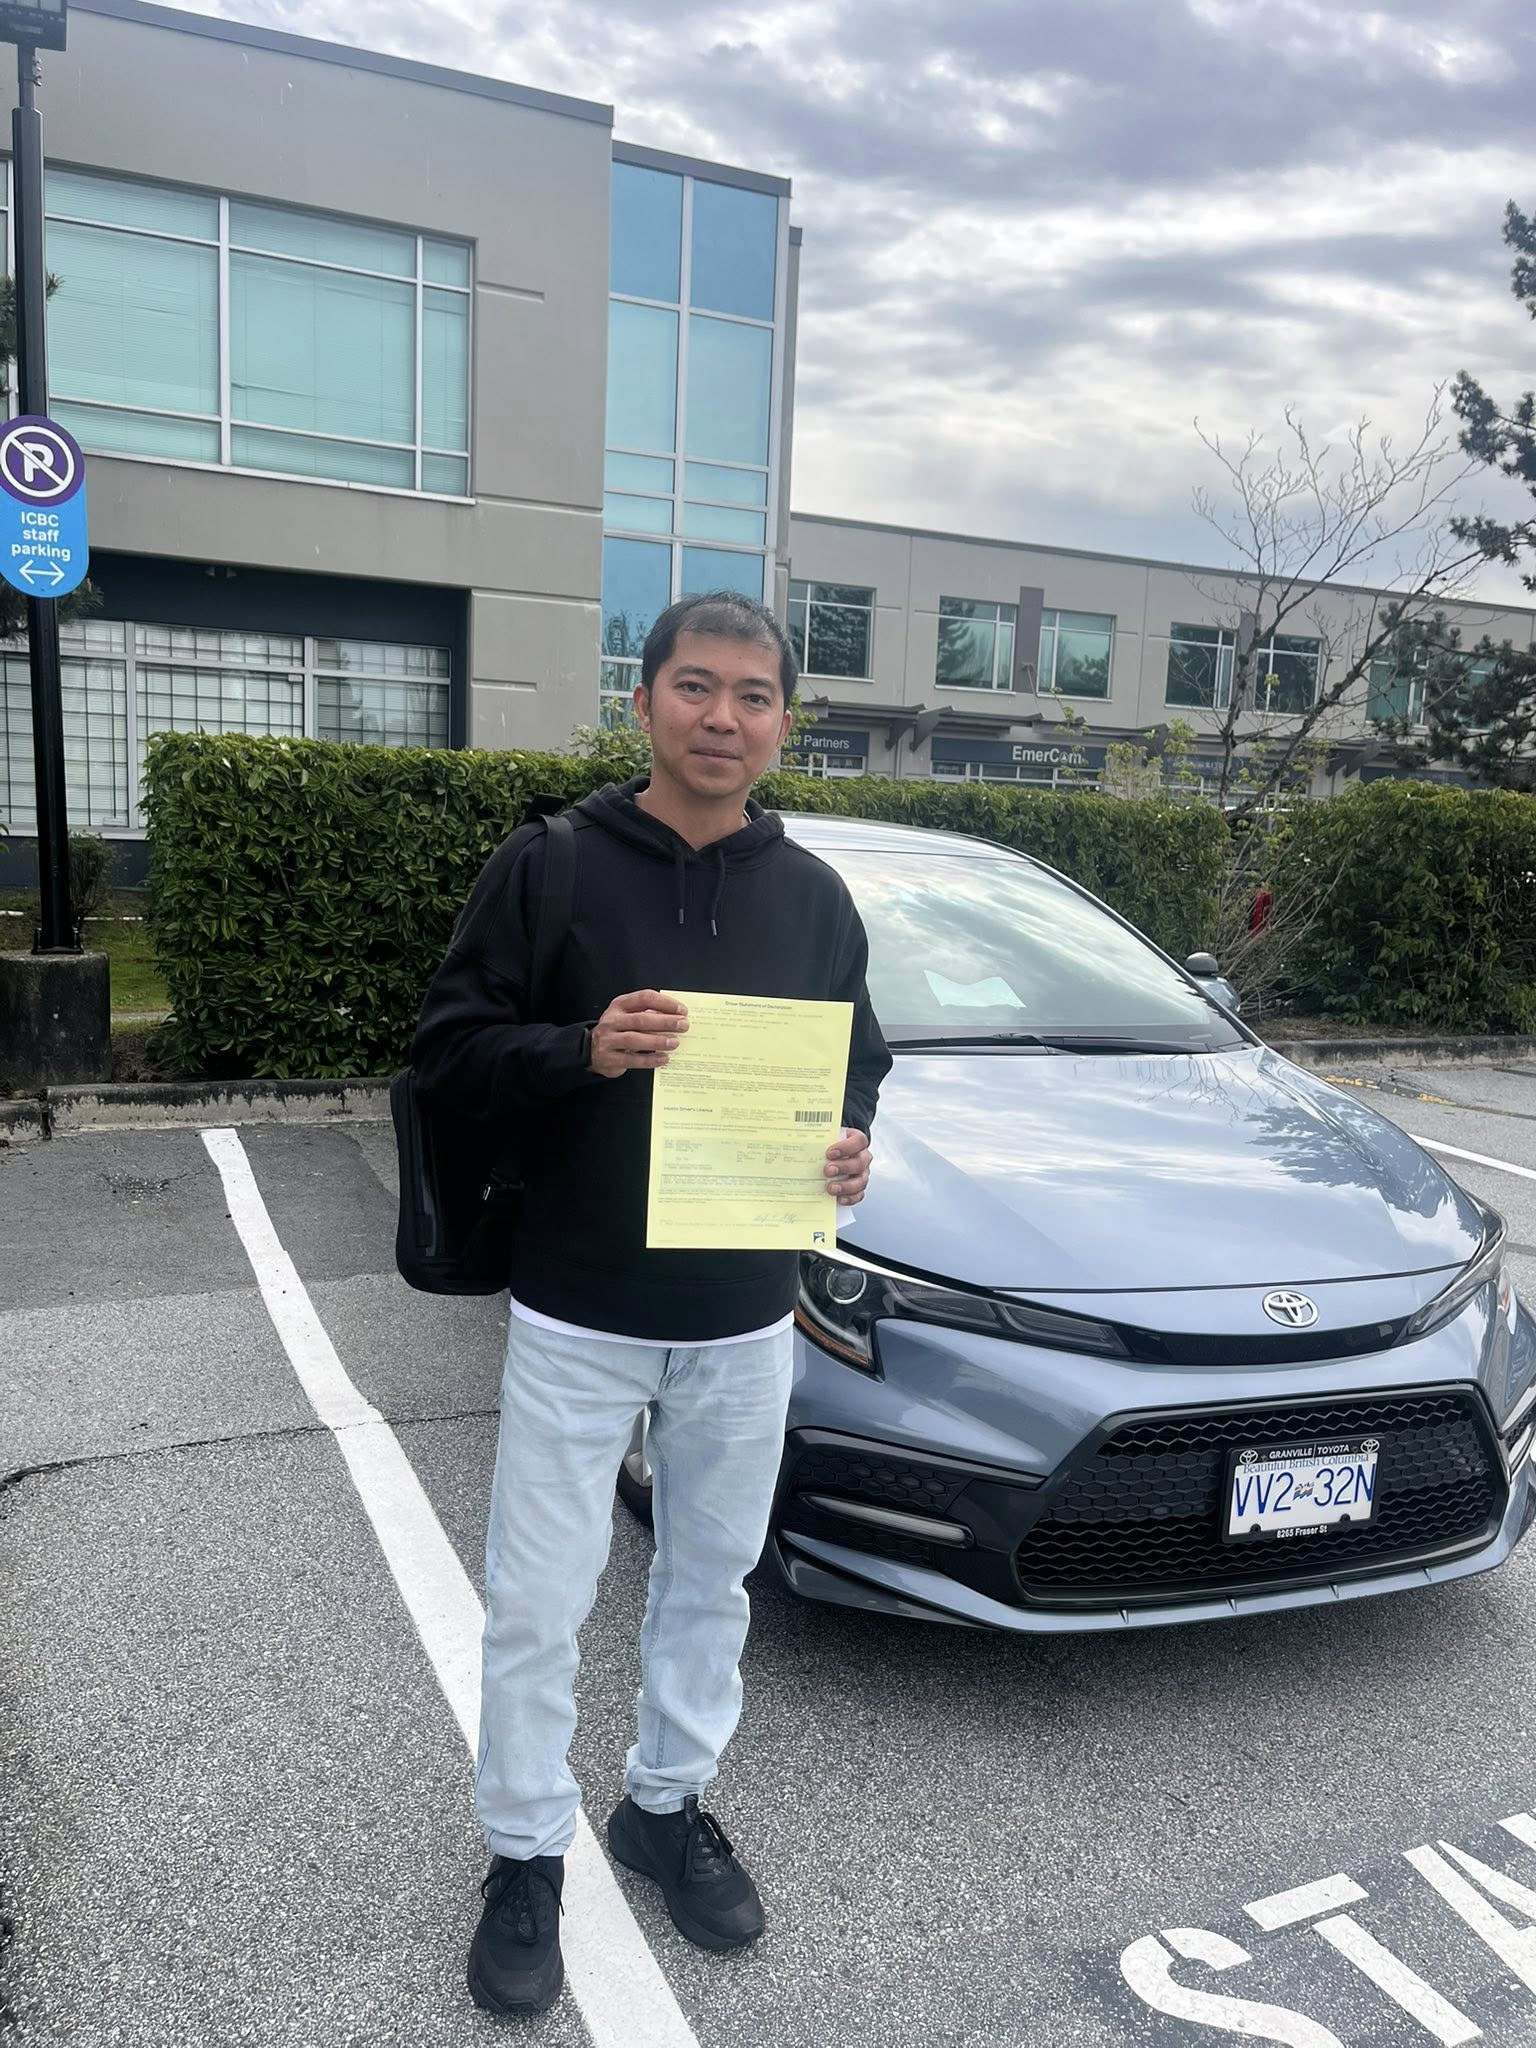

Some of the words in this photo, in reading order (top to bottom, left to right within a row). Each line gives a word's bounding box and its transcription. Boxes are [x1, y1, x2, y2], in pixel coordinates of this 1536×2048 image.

[21, 511, 60, 527] ICBC
[22, 528, 60, 543] staff
[11, 543, 71, 561] parking
[803, 734, 850, 750] Partners
[1269, 1447, 1313, 1460] GRANVILLE
[1317, 1444, 1350, 1455] TOYOTA
[1243, 1460, 1287, 1474] Beautiful
[1289, 1457, 1320, 1469] British
[1321, 1454, 1369, 1467] Columbia
[1235, 1471, 1294, 1517] VV2
[1314, 1463, 1376, 1507] 32N
[1276, 1527, 1294, 1539] 8265
[1295, 1525, 1318, 1538] Fraser
[1319, 1524, 1328, 1534] St
[1119, 1809, 1536, 2048] STA
